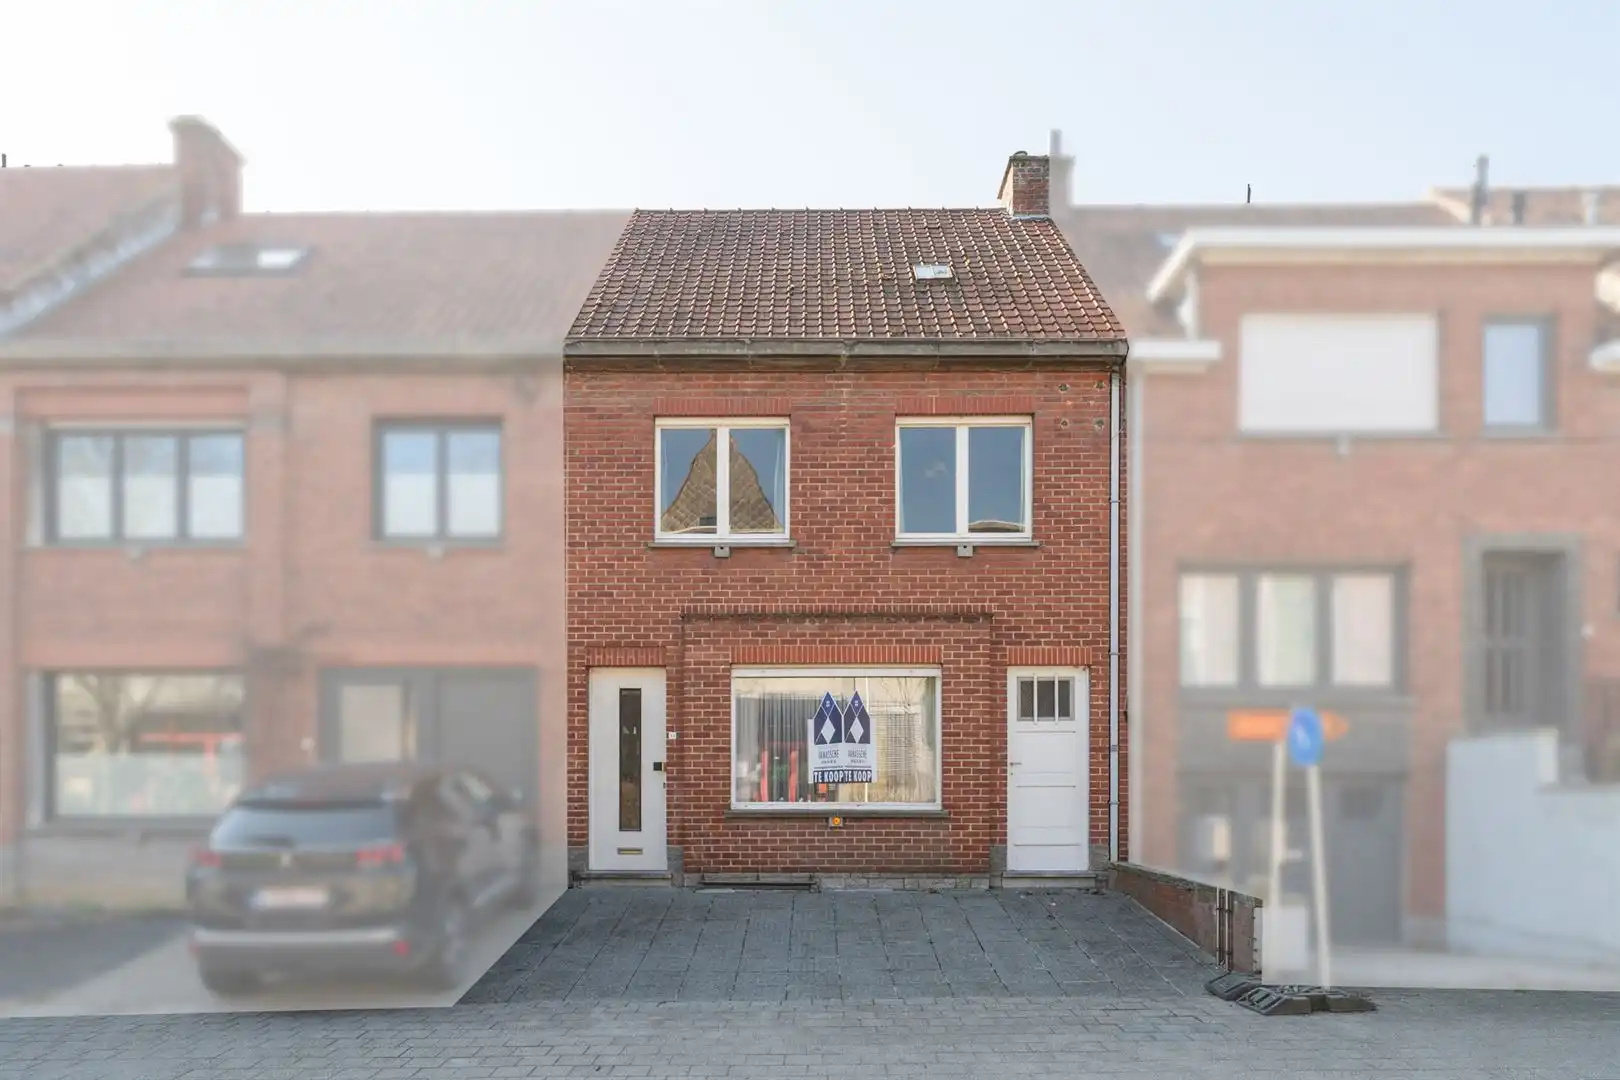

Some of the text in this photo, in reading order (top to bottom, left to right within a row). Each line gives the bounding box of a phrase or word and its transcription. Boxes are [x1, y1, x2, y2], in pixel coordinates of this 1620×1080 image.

[814, 771, 843, 782] TE KOOP
[844, 770, 871, 782] TE KOOP
